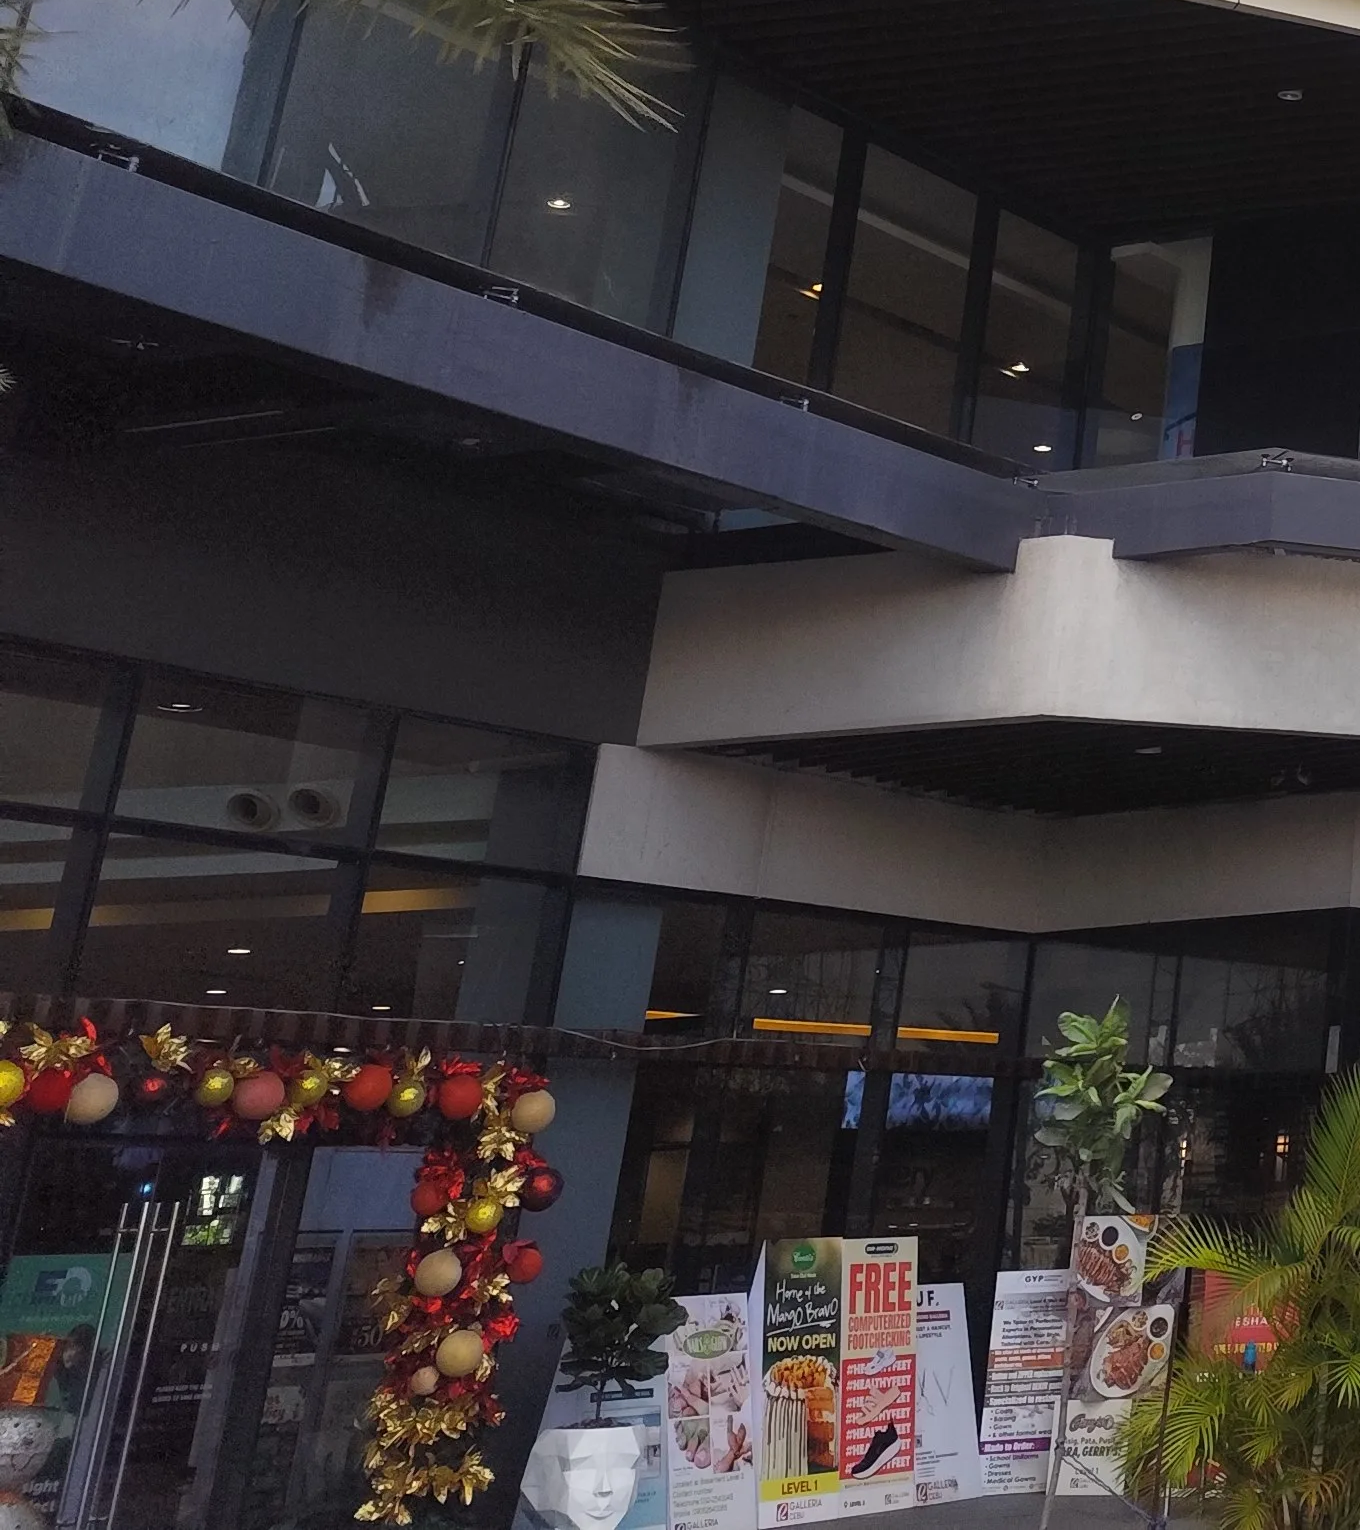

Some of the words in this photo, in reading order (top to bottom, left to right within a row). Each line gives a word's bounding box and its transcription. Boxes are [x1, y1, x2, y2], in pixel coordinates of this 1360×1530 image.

[1024, 1275, 1045, 1283] GYP
[776, 1279, 803, 1303] Home
[804, 1286, 812, 1296] of
[813, 1281, 826, 1295] the
[849, 1261, 912, 1315] FREE
[766, 1303, 803, 1330] Mango
[804, 1298, 839, 1323] Bravo
[848, 1313, 911, 1333] COMPUTERIZED
[180, 1342, 220, 1353] PUSH
[767, 1335, 800, 1352] NOW
[801, 1333, 836, 1350] OPEN
[847, 1330, 911, 1351] FOOTCHECKING
[989, 1454, 1011, 1462] School
[1012, 1453, 1039, 1461] Uniforms
[781, 1481, 813, 1495] LEVEL
[928, 1477, 959, 1490] GALLERIA
[789, 1500, 823, 1511] GALLERIA
[687, 1518, 719, 1529] GALLERIA
